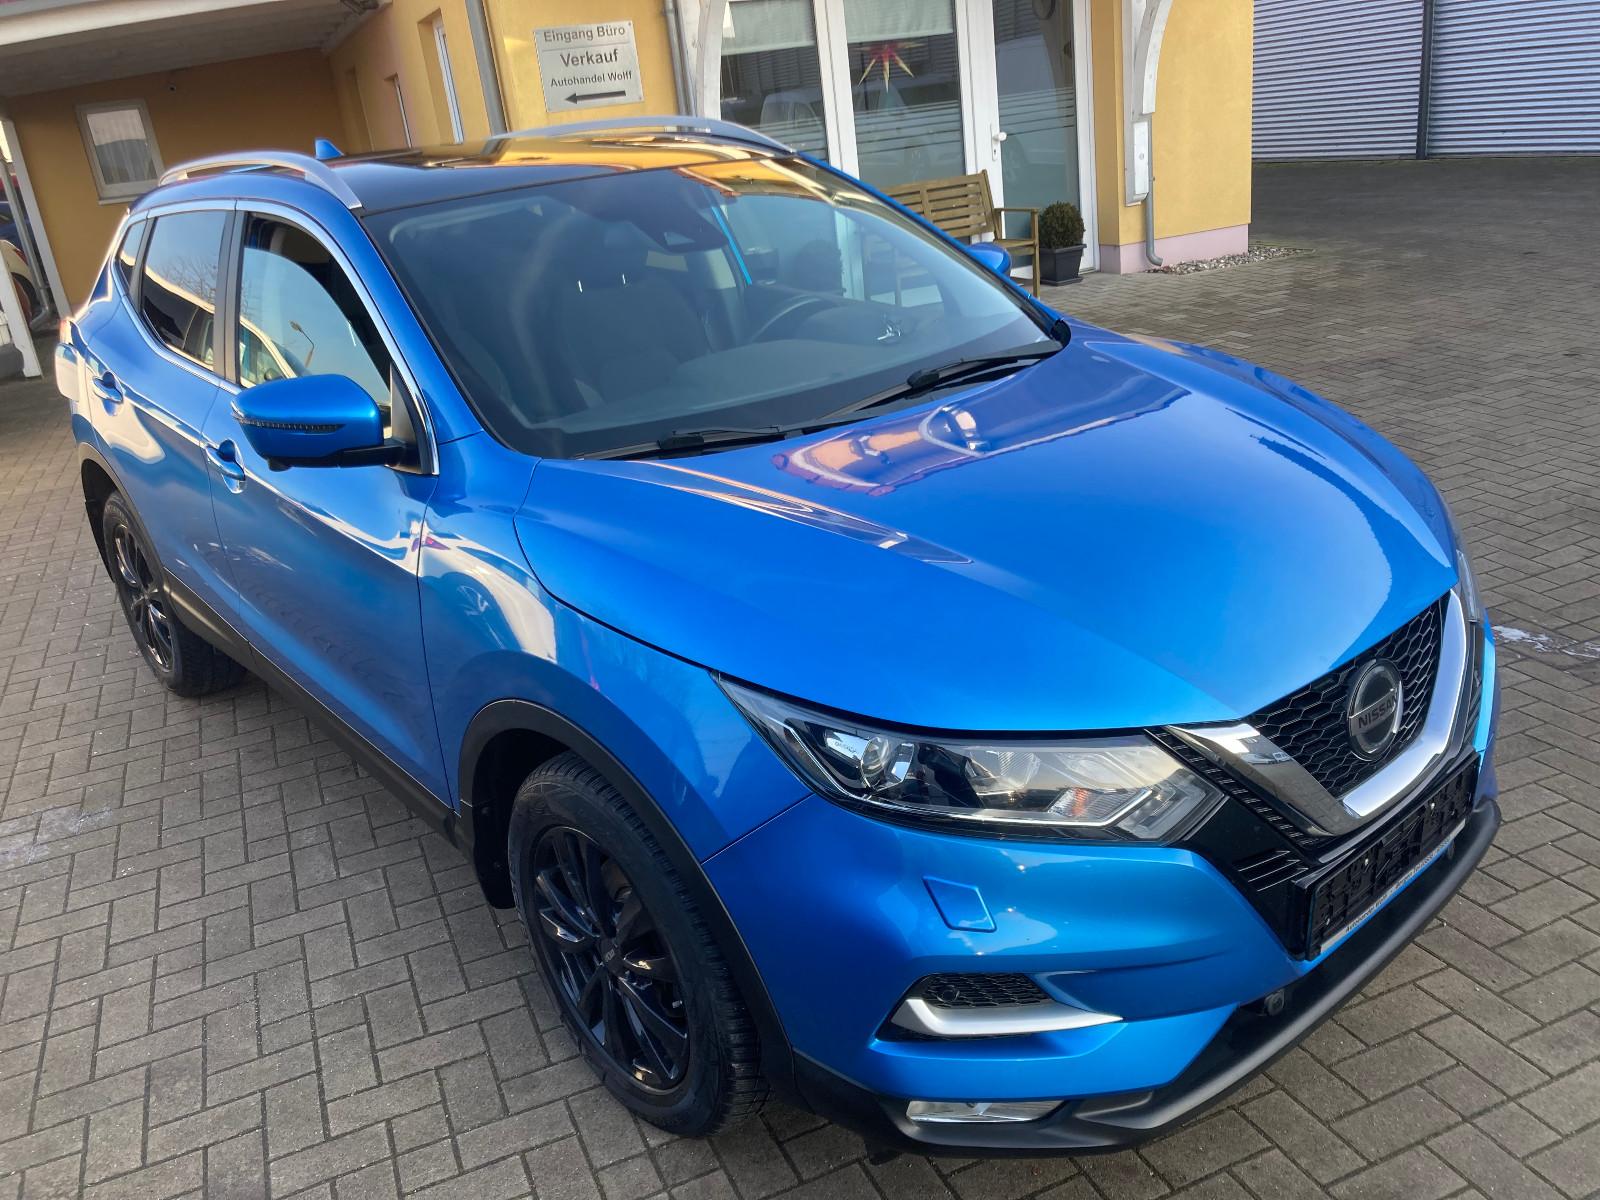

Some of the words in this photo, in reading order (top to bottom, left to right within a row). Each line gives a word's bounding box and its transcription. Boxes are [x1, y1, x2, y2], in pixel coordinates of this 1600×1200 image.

[543, 29, 593, 43] Eingang
[596, 25, 625, 37] Büro
[560, 48, 618, 67] Verkauf
[550, 74, 605, 87] Autohandel
[607, 70, 632, 81] Wolff
[1358, 694, 1396, 728] NISSAN
